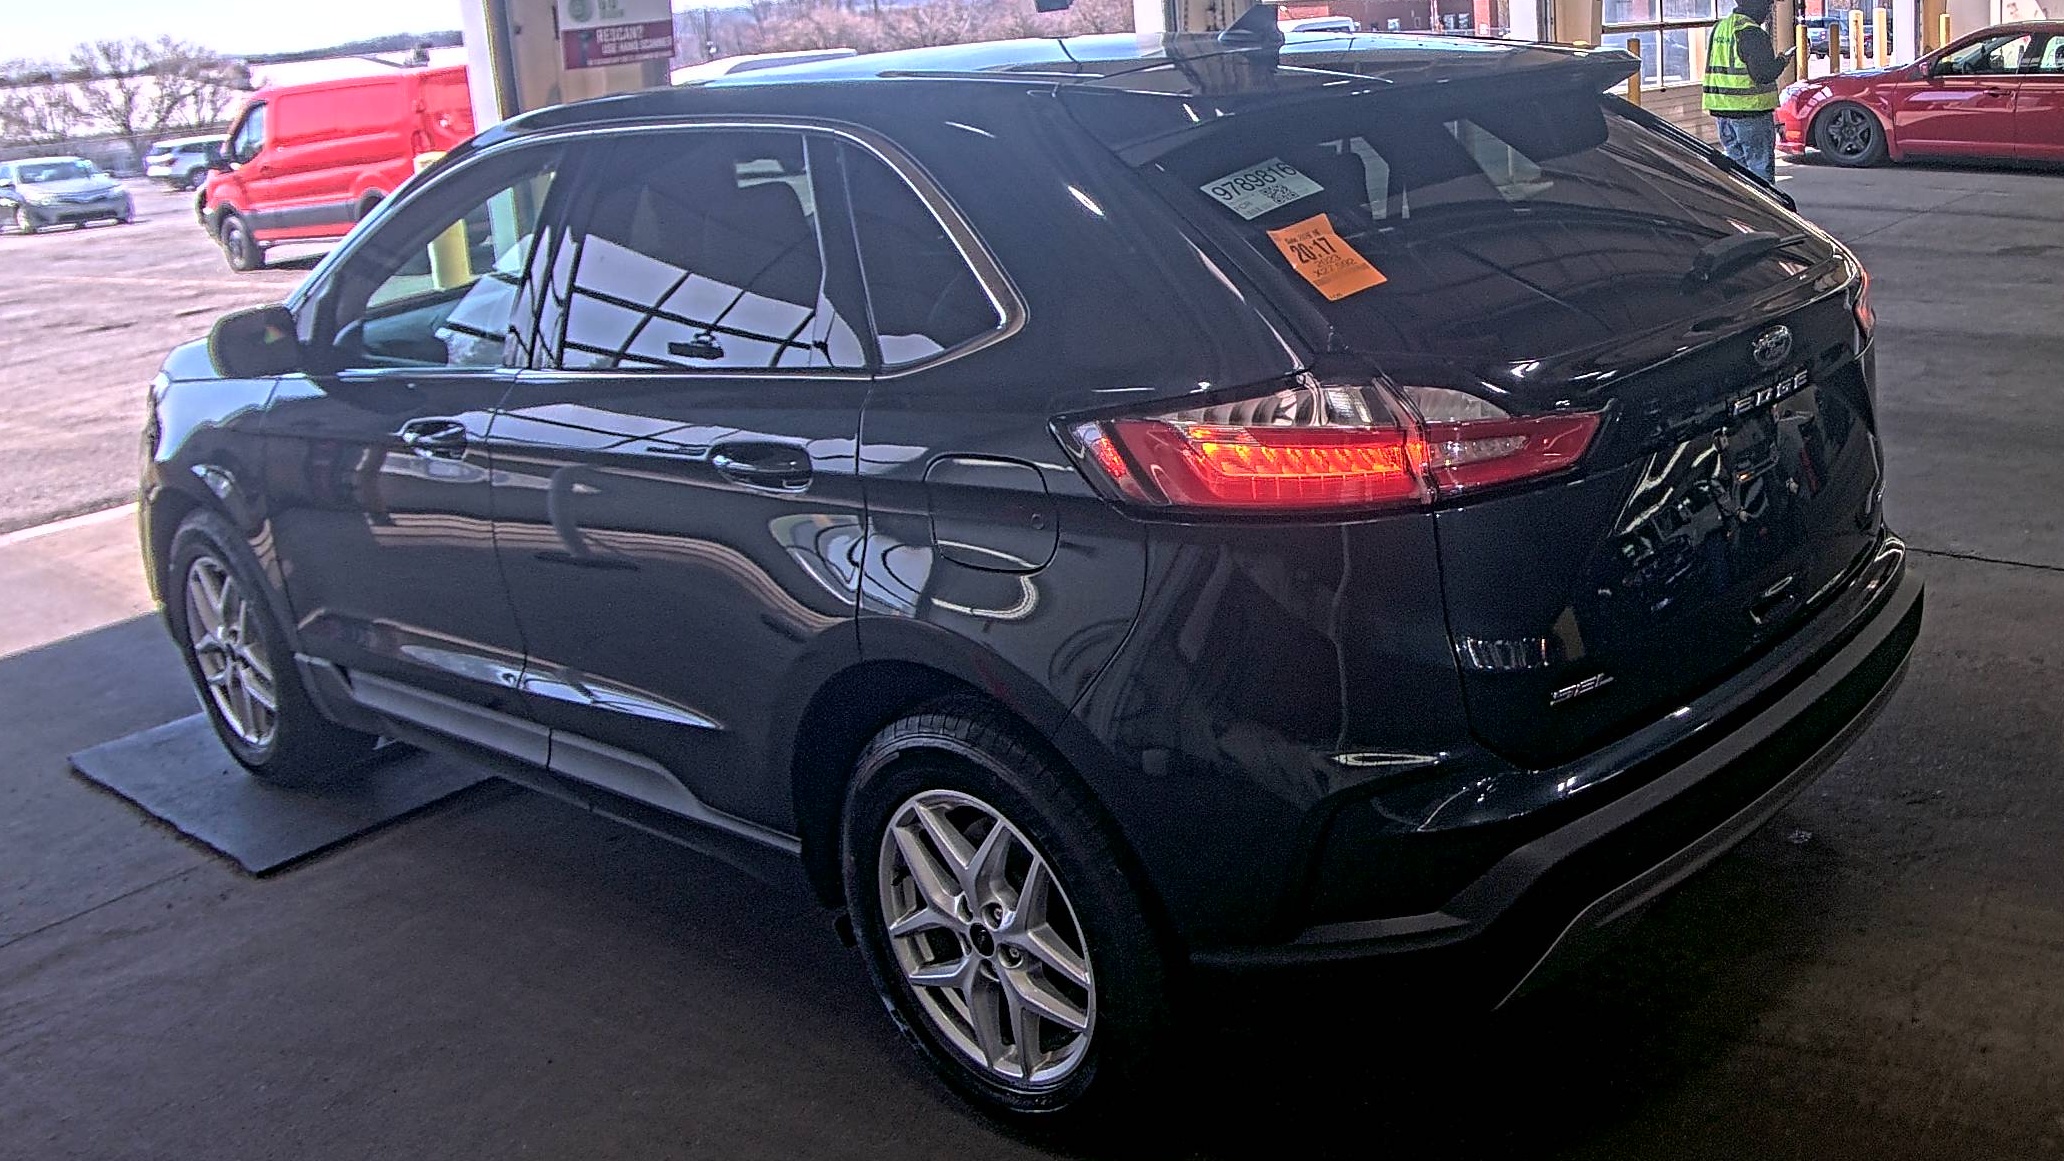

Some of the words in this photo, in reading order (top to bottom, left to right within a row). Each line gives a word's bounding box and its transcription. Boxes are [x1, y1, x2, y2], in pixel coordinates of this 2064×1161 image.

[1211, 162, 1297, 201] 9789816
[1289, 236, 1337, 264] 20:17
[1732, 368, 1809, 416] EDGE
[1549, 672, 1615, 706] SEL
